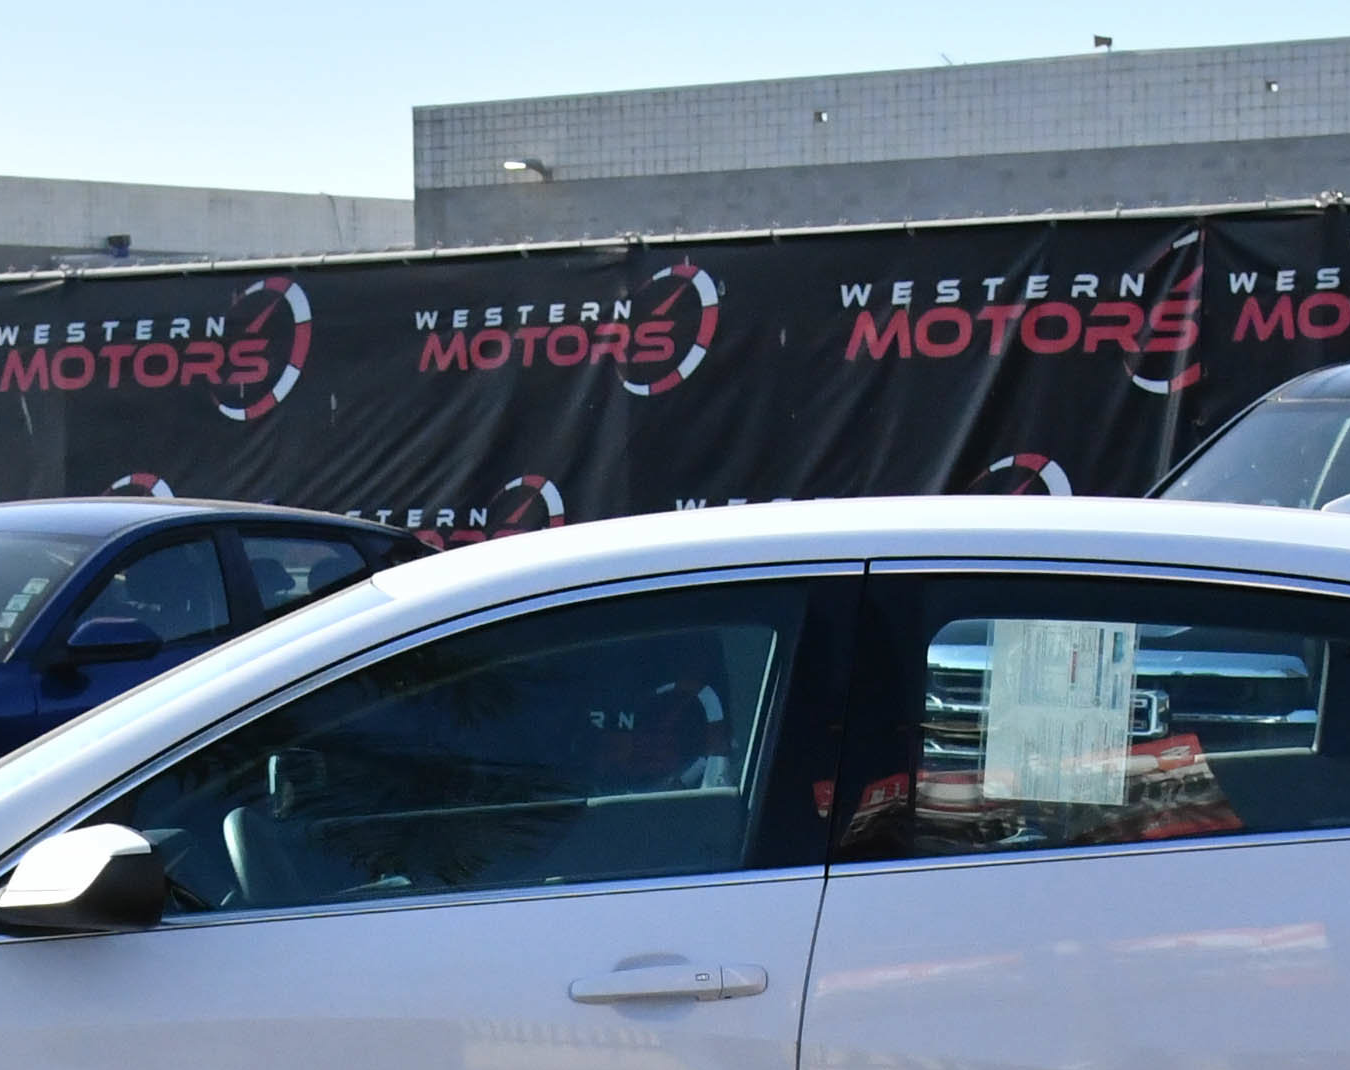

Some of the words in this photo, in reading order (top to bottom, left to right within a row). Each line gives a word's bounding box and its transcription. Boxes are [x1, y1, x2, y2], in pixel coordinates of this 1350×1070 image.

[415, 300, 632, 330] WESTERN
[840, 272, 1145, 308] WESTERN
[418, 319, 676, 373] MOTORS
[845, 299, 1200, 360] MOTORS
[0, 337, 270, 392] MOTORS
